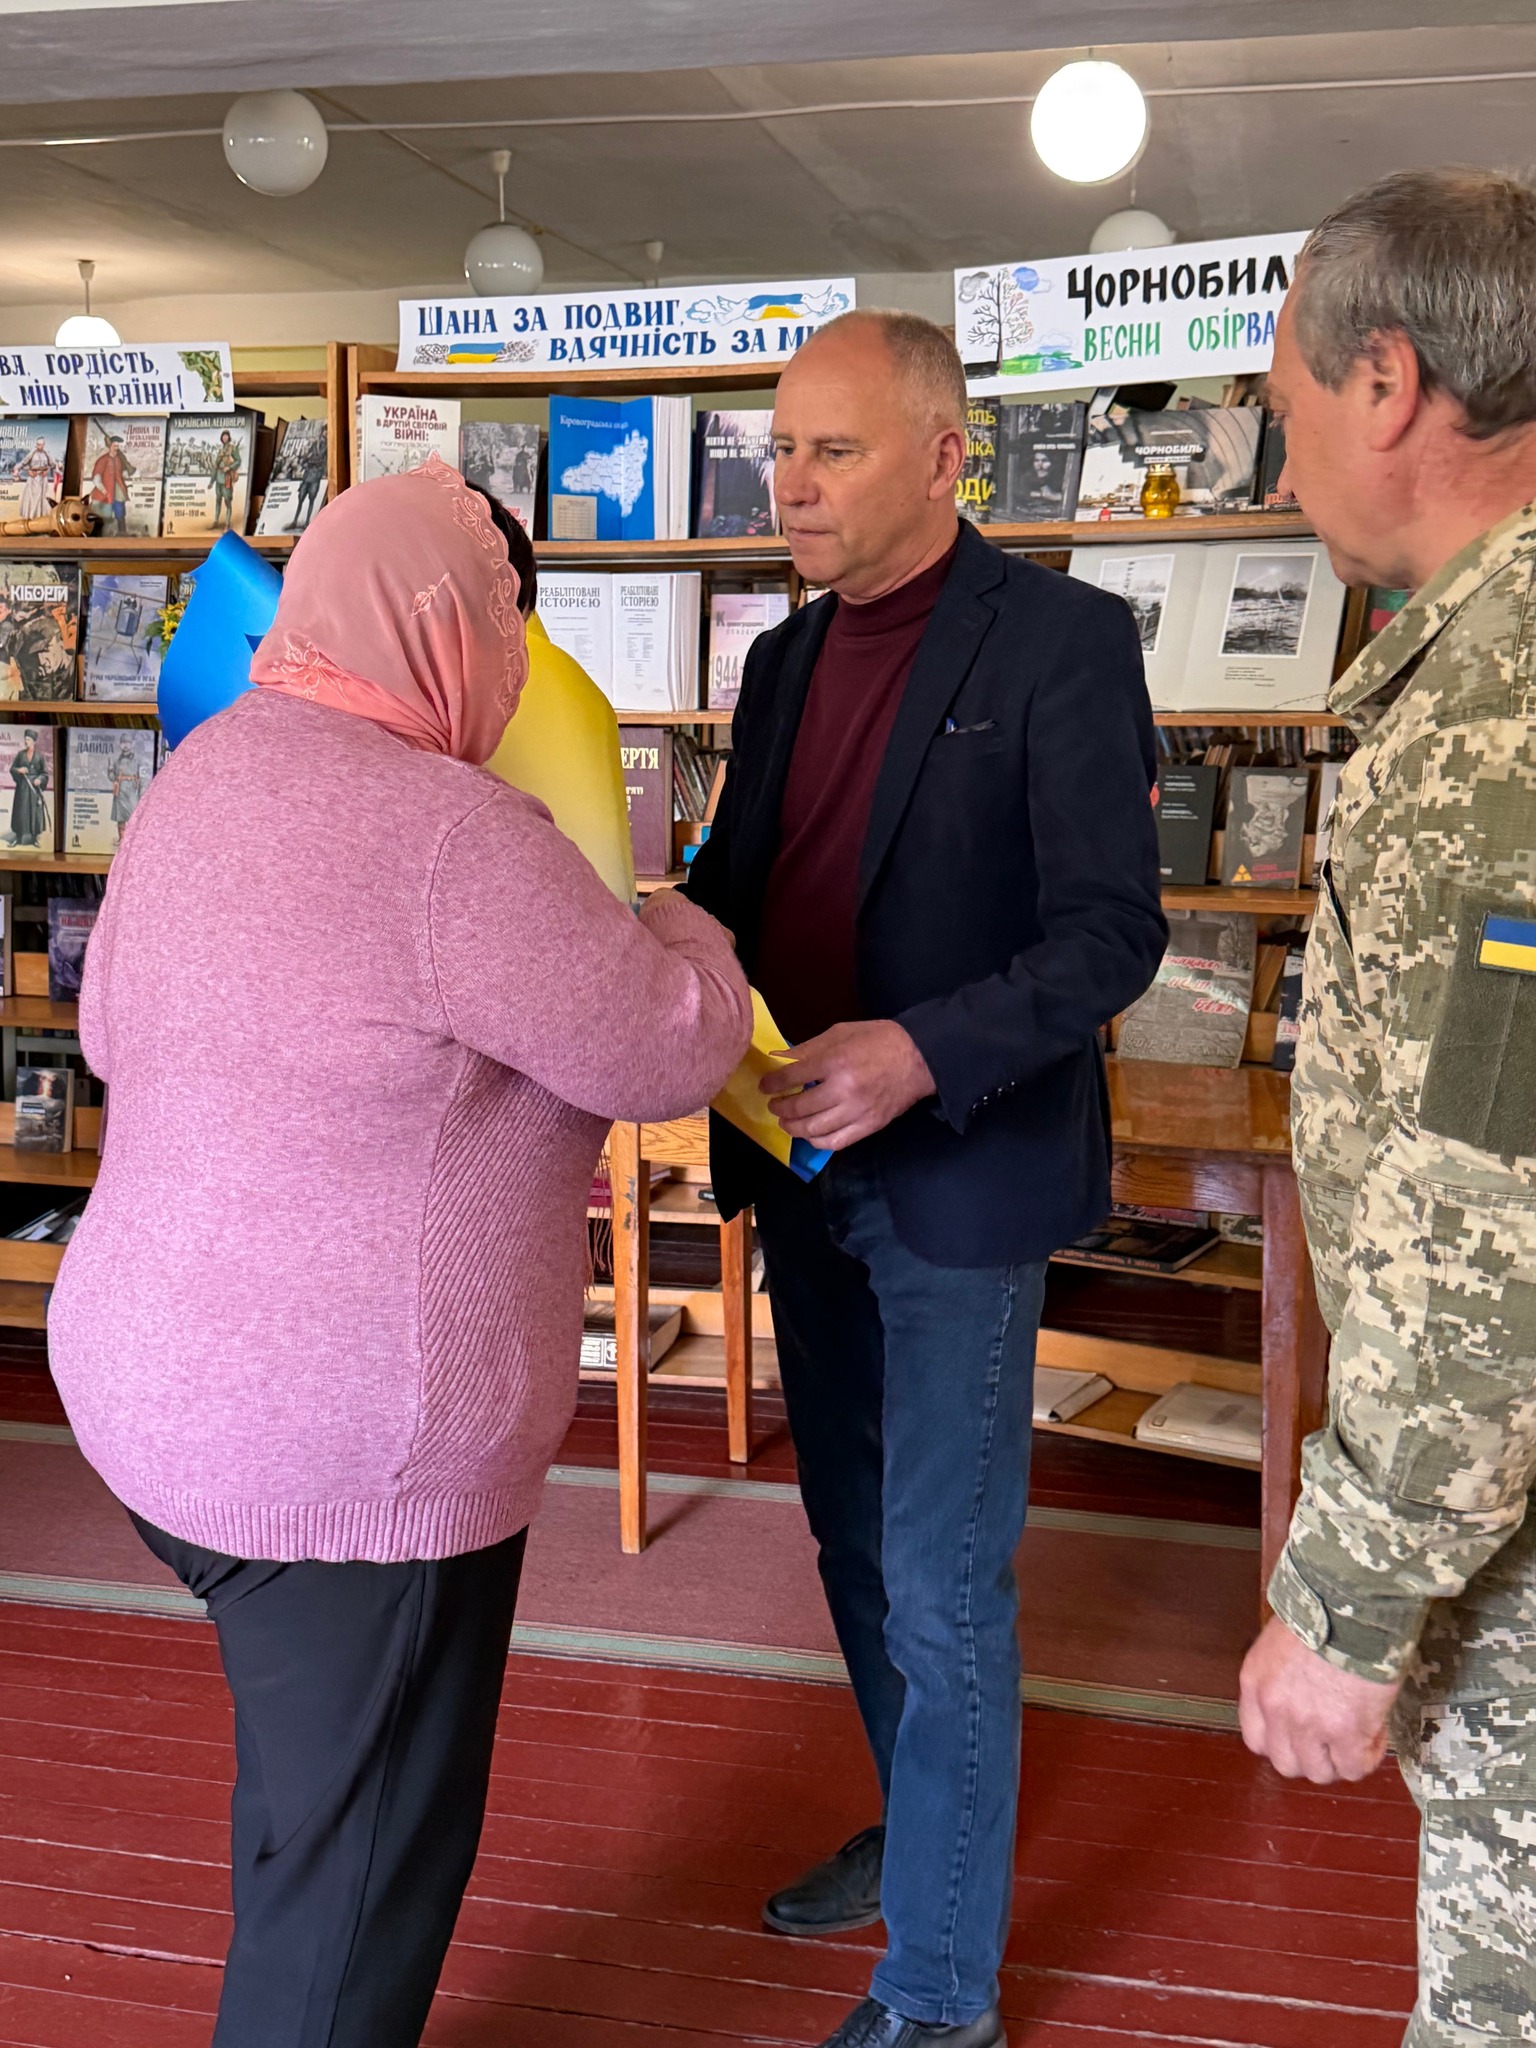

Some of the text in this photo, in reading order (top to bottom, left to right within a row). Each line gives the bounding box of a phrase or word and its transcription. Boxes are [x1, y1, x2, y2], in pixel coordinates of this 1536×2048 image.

[1067, 255, 1296, 320] ЧОРНОБИЛ
[418, 300, 684, 336] ШАНА ЗА ПОДВИГ,
[1083, 307, 1275, 361] ВЕСНИ ОБІРВА
[547, 327, 716, 363] ВДЯЧНІСТЬ
[731, 328, 767, 353] ЗА
[45, 348, 159, 380] ГОРДІСТЬ,
[20, 374, 184, 410] МІЦЬ КРАЇНИ!
[383, 405, 438, 421] УКРАЇНА
[376, 418, 447, 431] В ДРУГІЙ СВІТОВІЙ
[395, 428, 429, 441] ВІЙНІ:
[1135, 444, 1203, 455] ЧОРНОБИЛЬ
[10, 585, 69, 602] КІБОРГИ
[539, 587, 600, 597] РЕАБІЛІТОВАНІ
[620, 585, 659, 596] РЕАБІЛІТОВАНІ
[540, 597, 601, 608] ІСТОРІЄЮ
[620, 596, 659, 607] ІСТОРІЄЮ
